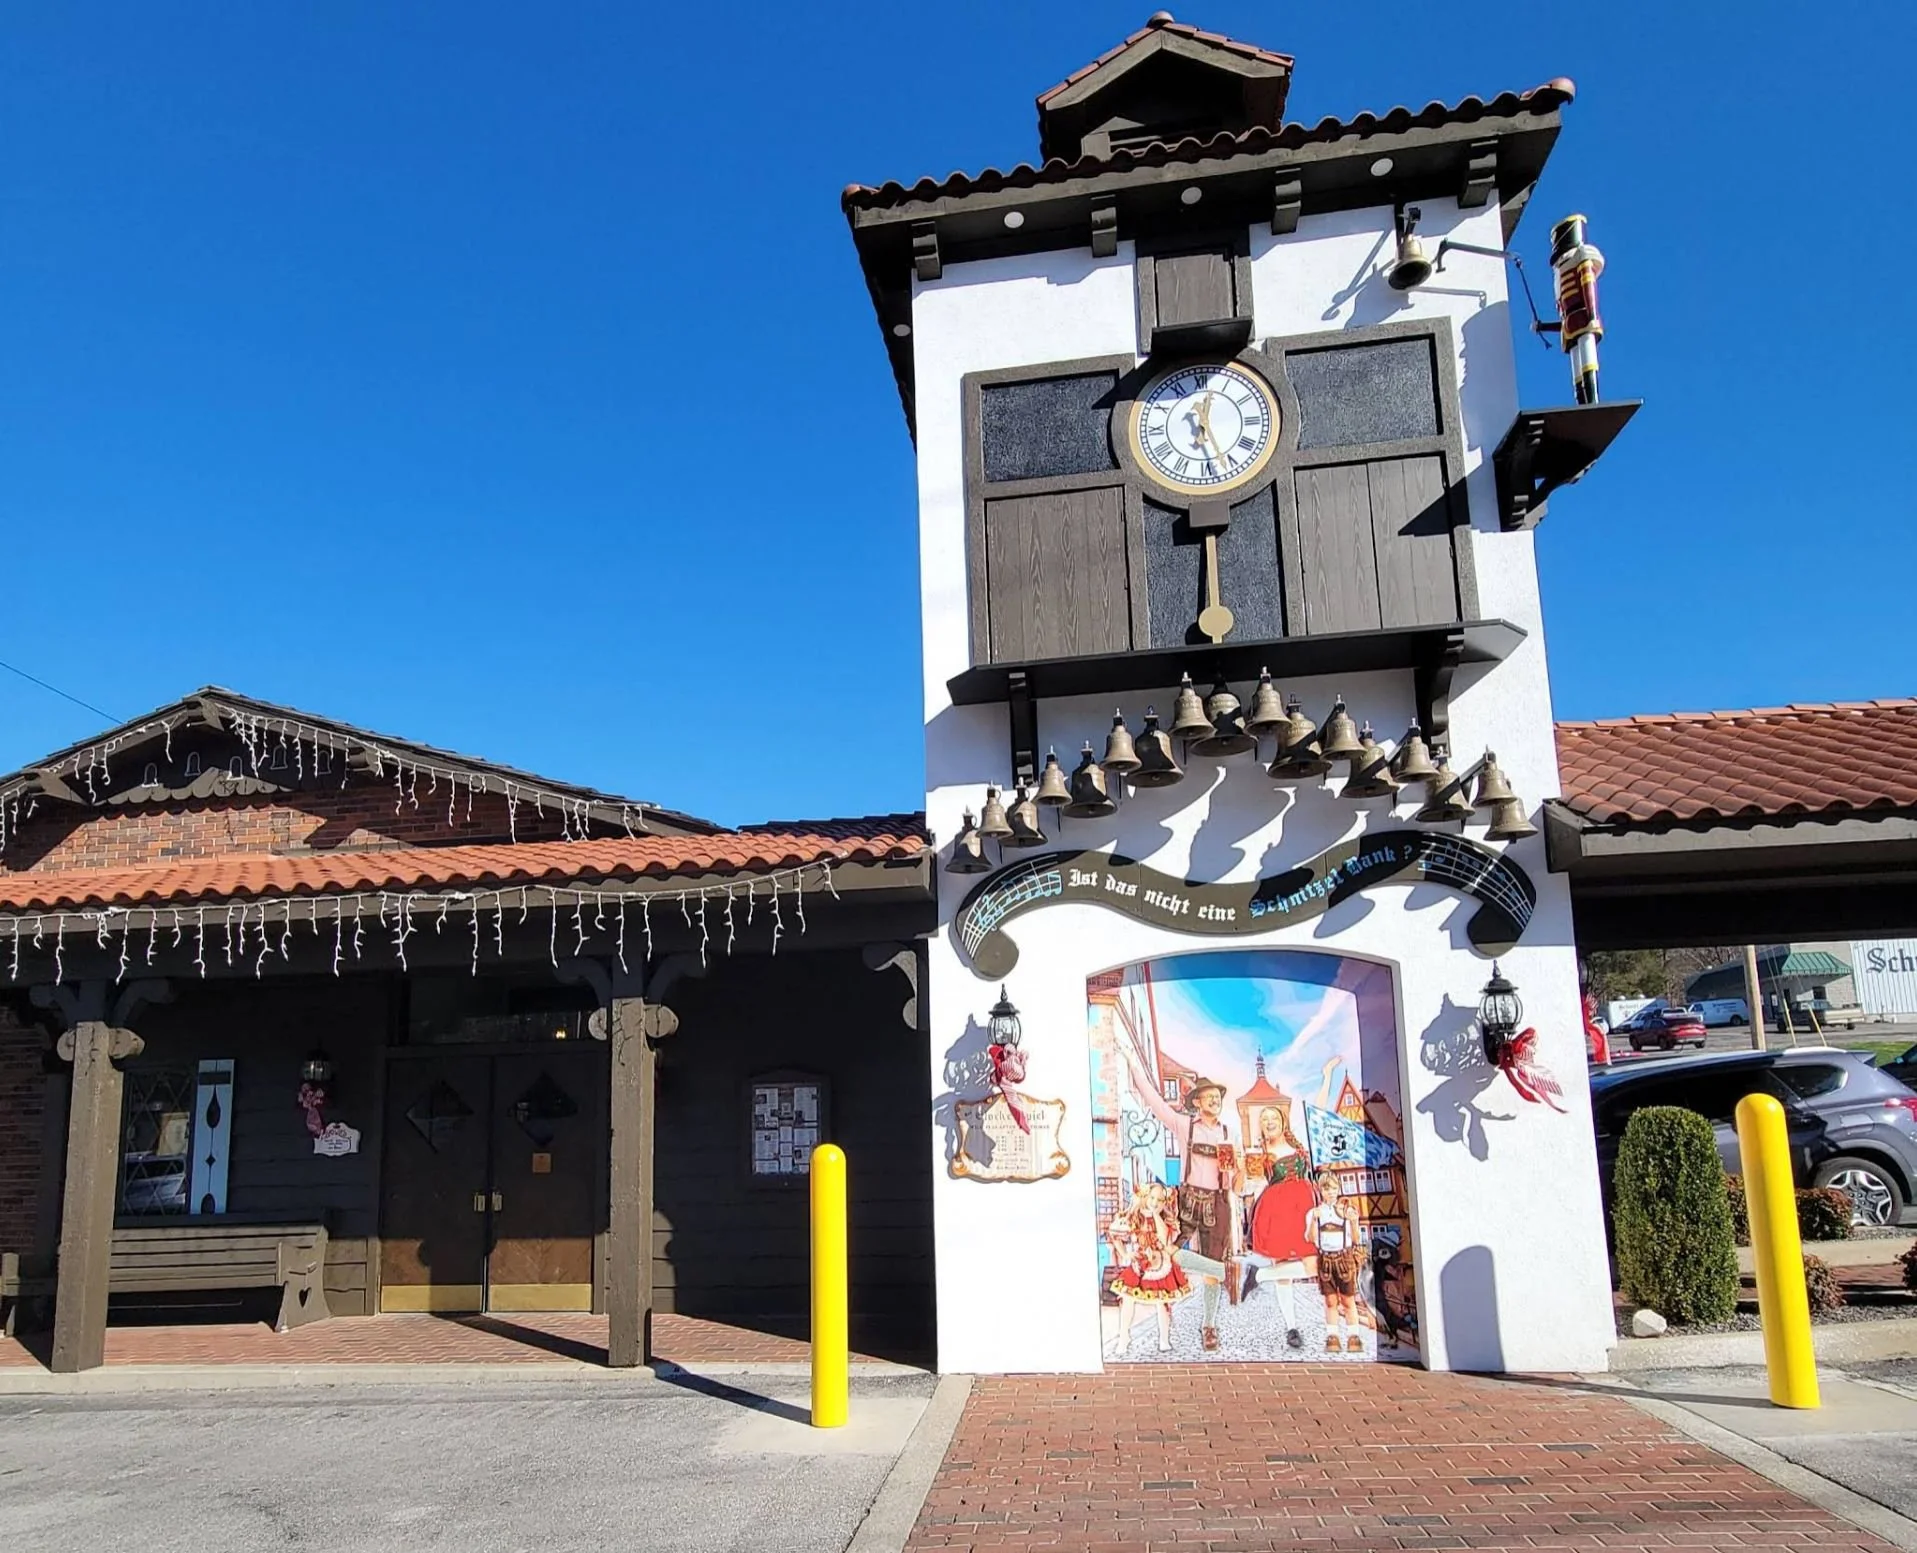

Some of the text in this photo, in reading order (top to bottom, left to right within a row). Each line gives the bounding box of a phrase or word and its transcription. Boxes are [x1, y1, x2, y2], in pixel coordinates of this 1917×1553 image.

[1194, 375, 1208, 390] XII
[1170, 382, 1186, 399] XI
[1237, 394, 1253, 406] II
[1154, 403, 1169, 414] X
[1244, 416, 1261, 426] III
[1149, 425, 1164, 436] IX
[1153, 441, 1173, 460] VIII
[1173, 456, 1189, 474] VII
[1227, 454, 1239, 468] V
[1200, 461, 1214, 477] VI
[1104, 873, 1138, 897] das
[1144, 889, 1190, 916] nicht
[1198, 904, 1236, 922] eine
[1250, 867, 1345, 920] Schnitzel
[1342, 845, 1397, 876] Bank
[1866, 947, 1917, 974] Sch
